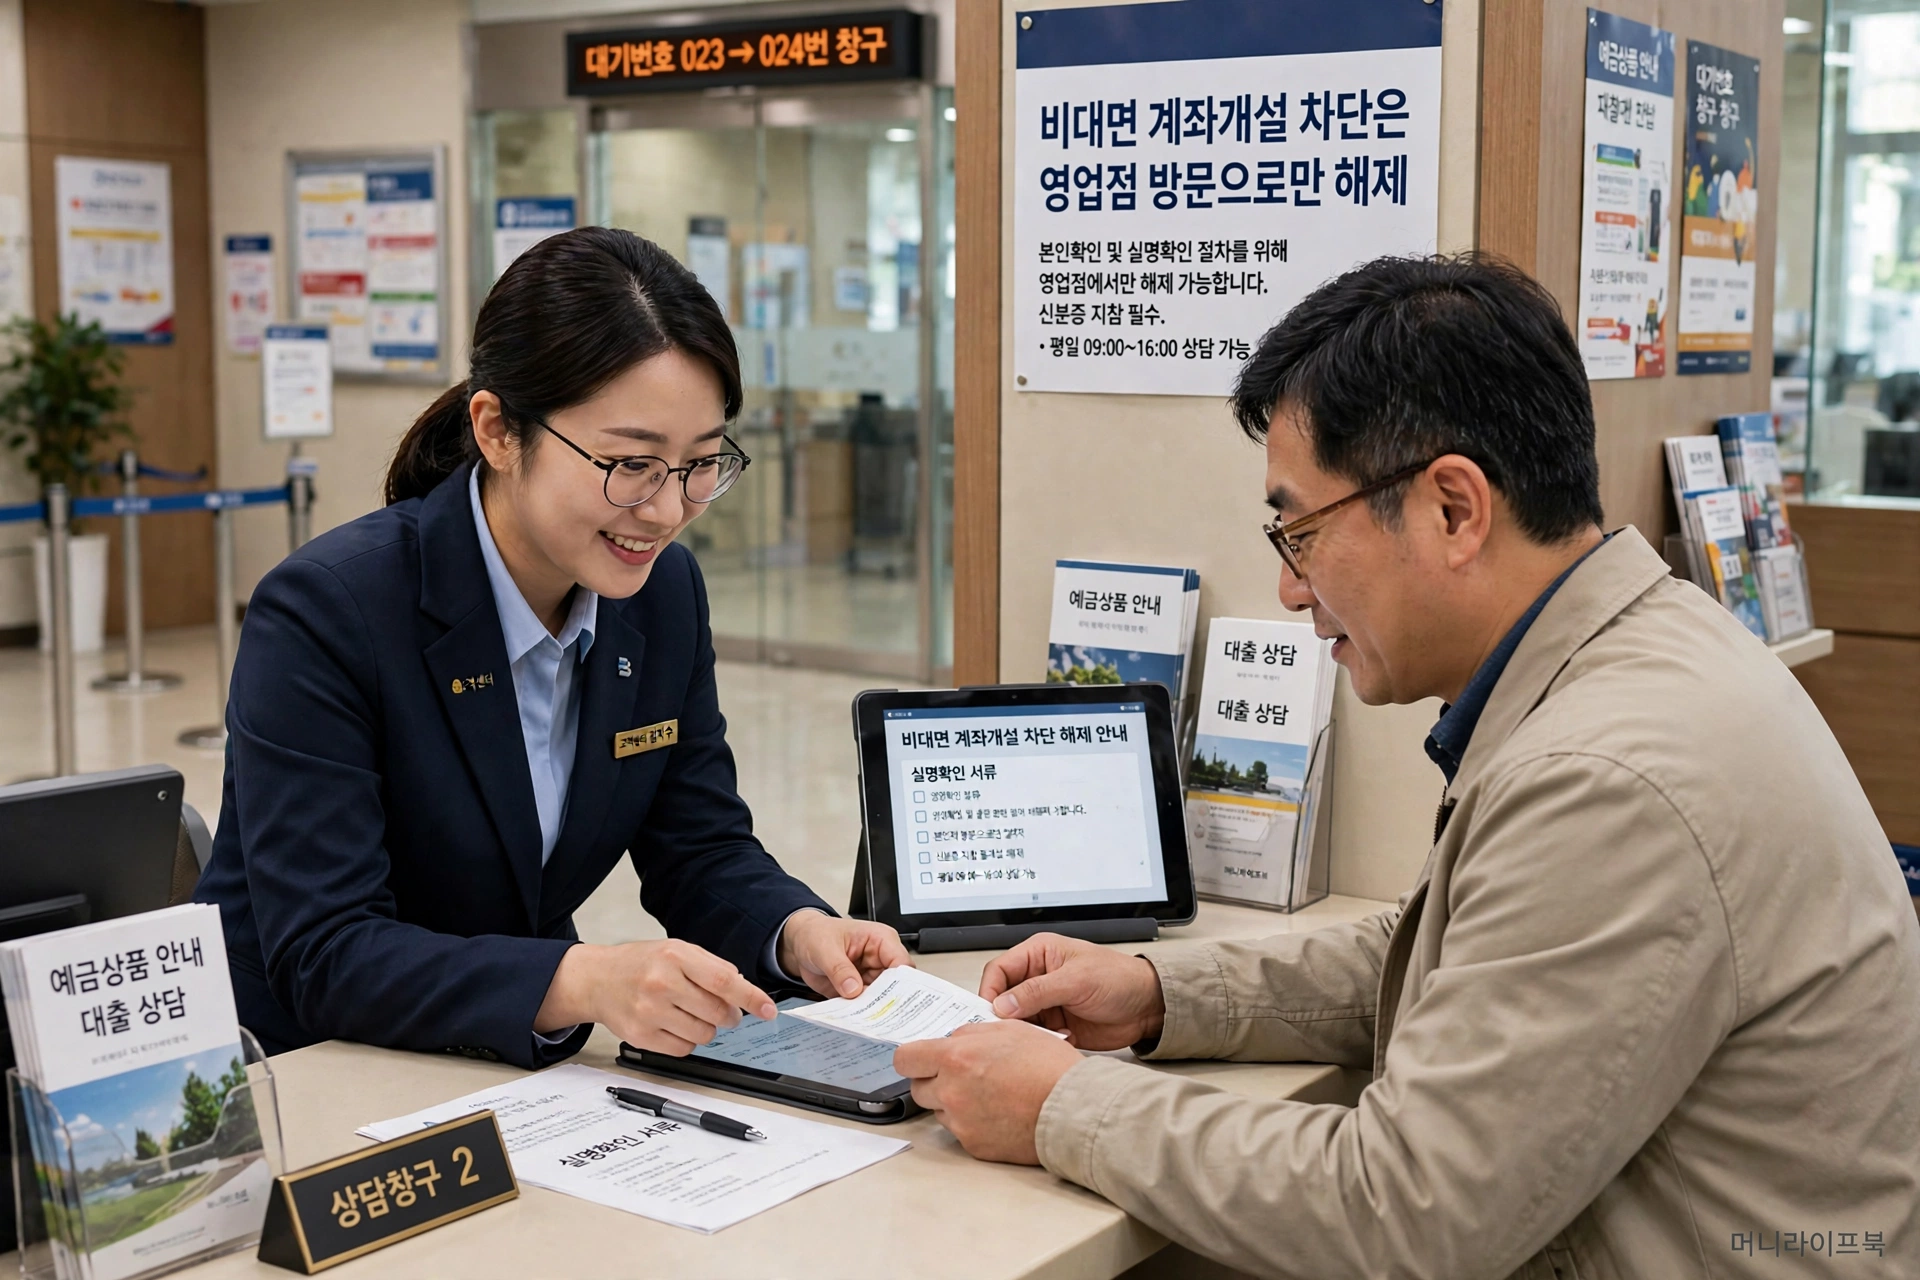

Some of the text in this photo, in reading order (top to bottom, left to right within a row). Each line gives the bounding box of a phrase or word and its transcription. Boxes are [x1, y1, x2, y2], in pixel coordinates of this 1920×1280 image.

[586, 27, 886, 77] 대기번호 023 024번 창구
[1042, 89, 1409, 149] 비대면 계좌개설 차단은
[1040, 155, 1407, 212] 영업점 방문으로만 해제
[1039, 239, 1287, 263] 본인확인 및 실명확인 절차를 위해
[1040, 271, 1267, 295] 영업점에서만 해제 가능합니다.
[1039, 303, 1165, 325] 신분증 지참 필수.
[1050, 336, 1252, 361] 평일 09:00~16:00 상담 가능
[1070, 590, 1161, 615] 예금상품 안내
[1225, 641, 1297, 666] 대출 상담
[1218, 700, 1289, 725] 대출 상담
[902, 724, 1127, 749] 비대면 계좌개설 차단 해제 안내
[912, 765, 996, 782] 실명확인 서류
[51, 937, 203, 995] 예금상품 안내
[81, 986, 185, 1036] 대출 상담
[559, 1121, 682, 1167] 실명확인 서류
[329, 1147, 479, 1229] 상담창구 2
